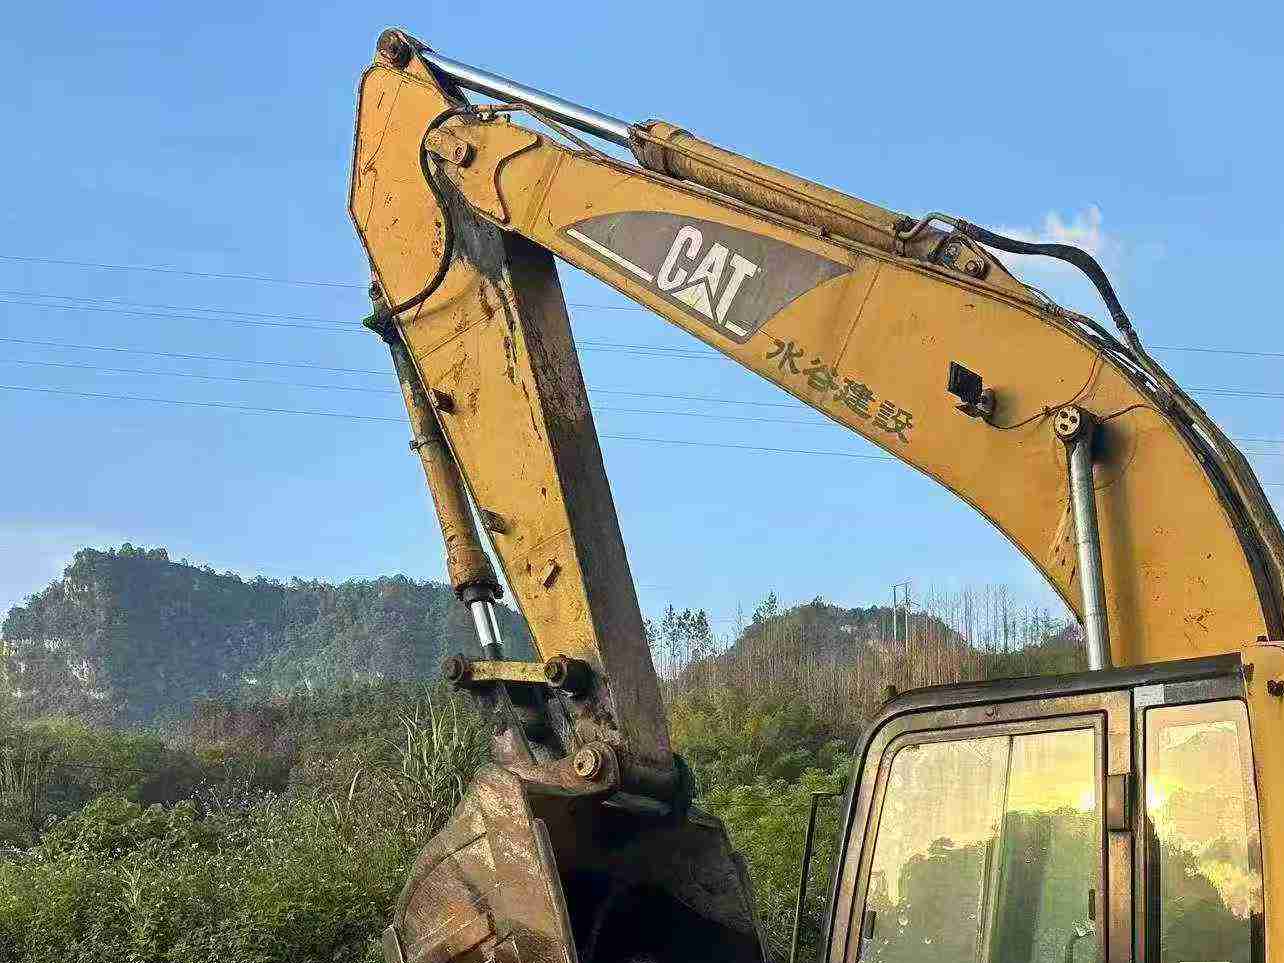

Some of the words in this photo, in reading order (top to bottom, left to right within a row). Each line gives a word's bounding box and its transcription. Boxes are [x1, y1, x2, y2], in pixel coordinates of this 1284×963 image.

[656, 225, 760, 326] CAT
[764, 338, 914, 445] 水谷建設
